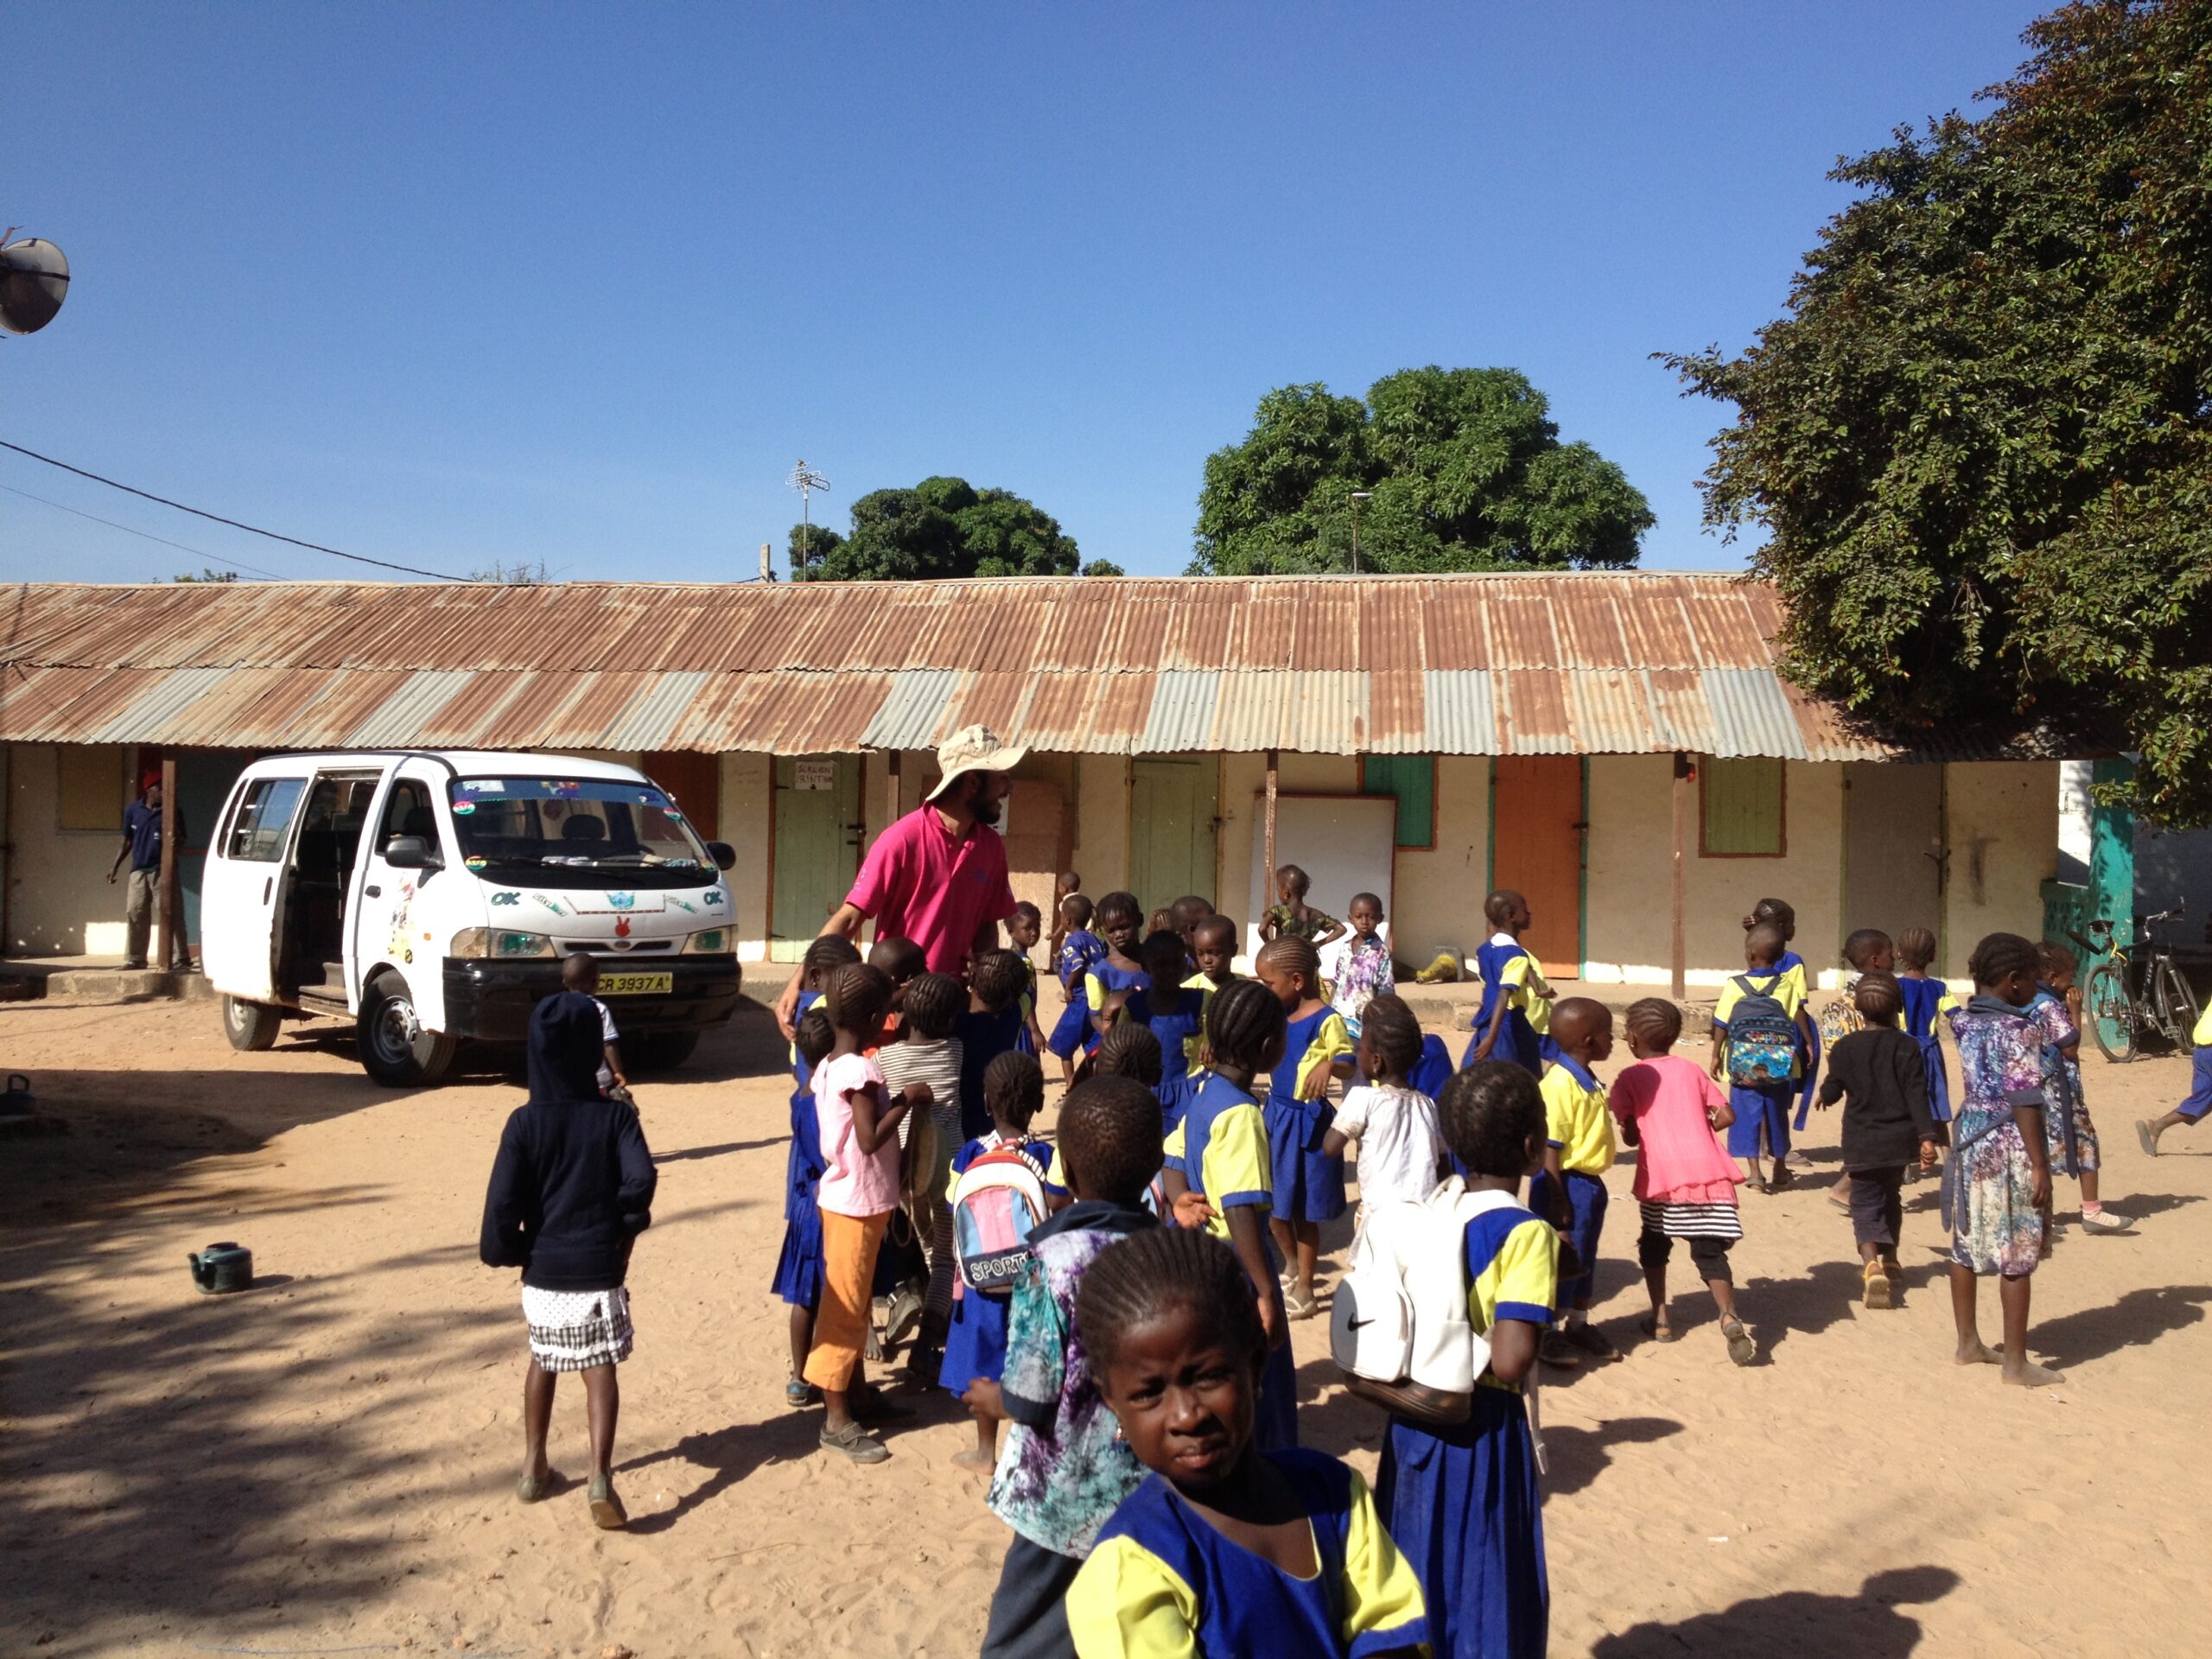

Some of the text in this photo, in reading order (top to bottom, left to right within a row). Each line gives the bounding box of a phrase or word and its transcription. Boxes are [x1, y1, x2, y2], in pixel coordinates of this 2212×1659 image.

[491, 892, 521, 906] OK
[703, 891, 724, 906] OK
[617, 977, 655, 990] 3937
